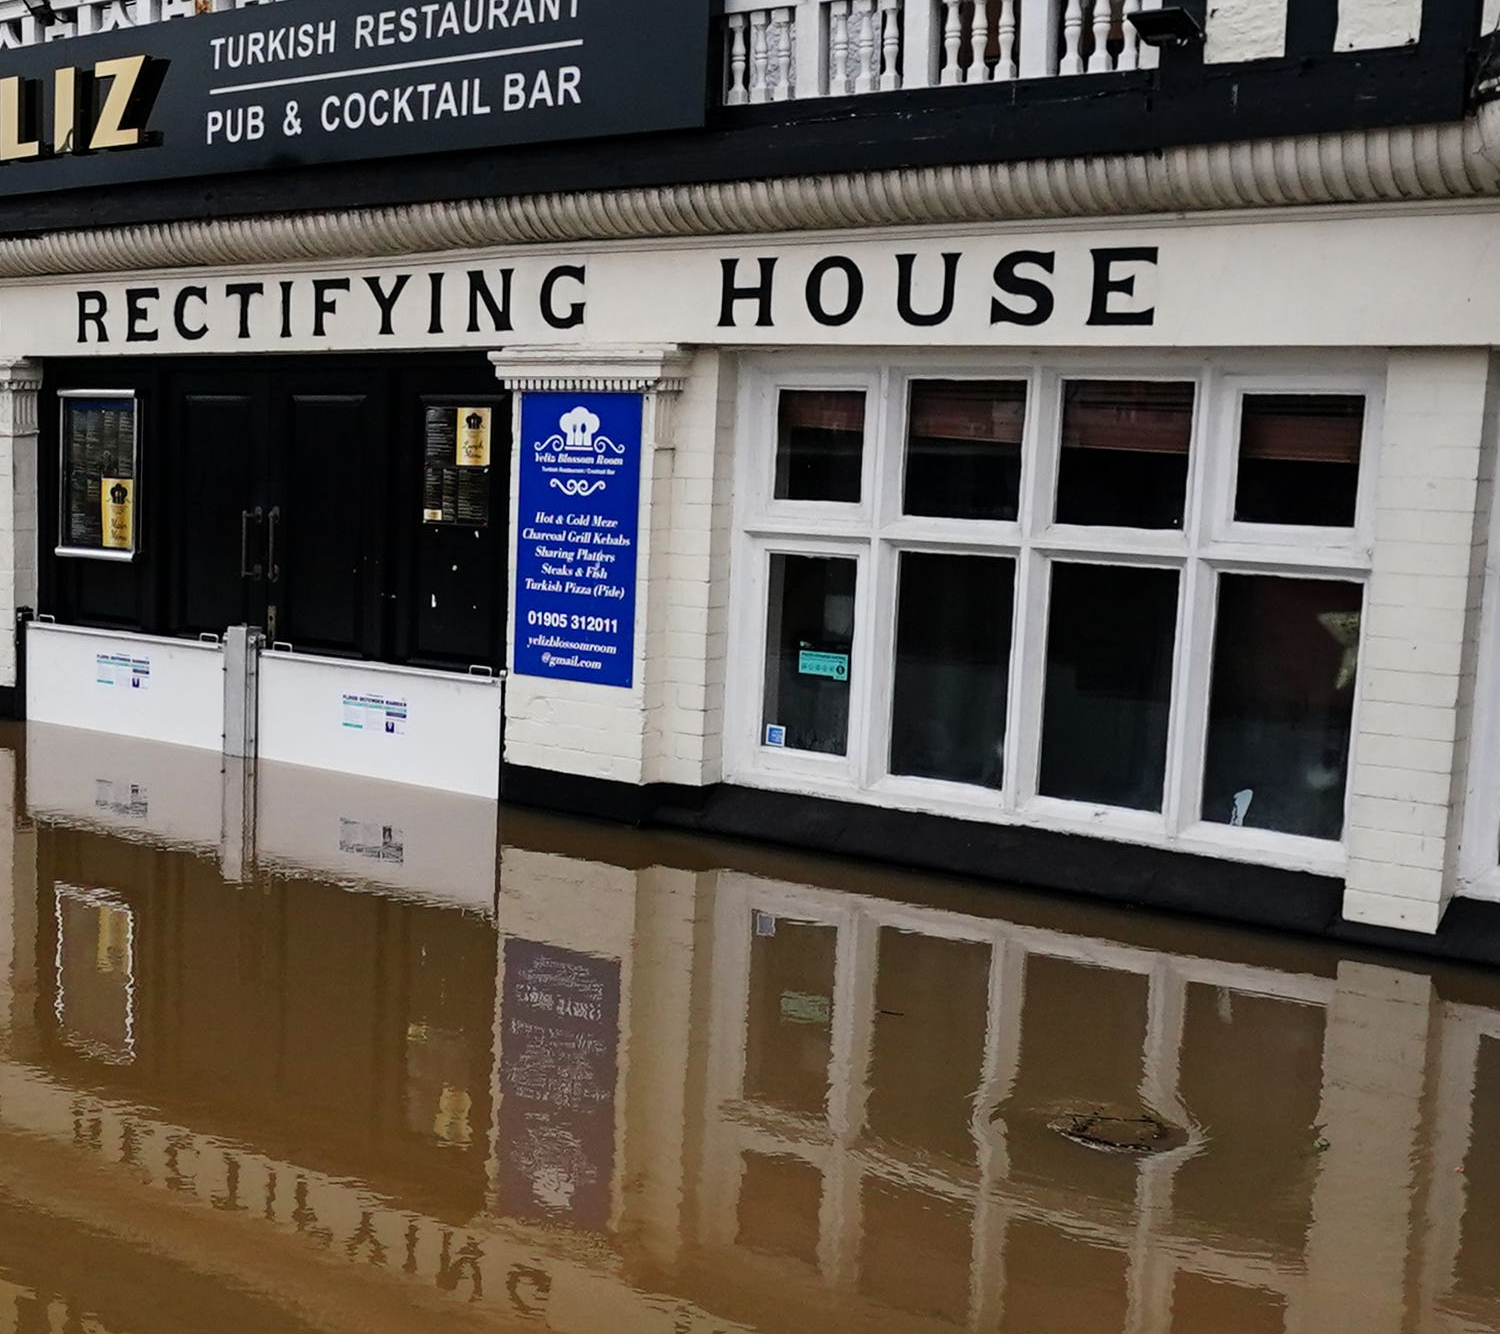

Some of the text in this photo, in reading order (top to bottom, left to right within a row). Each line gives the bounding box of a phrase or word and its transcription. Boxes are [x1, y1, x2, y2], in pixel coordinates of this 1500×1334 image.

[210, 17, 336, 69] TURKISH
[206, 64, 583, 145] PUB & COCKTAIL BAR
[77, 264, 588, 344] RECTIFYING
[716, 246, 1159, 327] HOUSE
[534, 452, 623, 465] Yeliz Blossom Room
[535, 511, 618, 527] Hot & Cold Meze
[522, 527, 630, 546] Charcoal Grill Kebabs
[535, 544, 614, 562] Sharing Platters
[541, 562, 607, 579] Steaks & Fish
[525, 578, 624, 599] Turkish Pizza (Pide)
[527, 610, 617, 633] 01905 312011
[526, 634, 616, 654] yelizblossomroom
[541, 651, 601, 669] @gmail.com
